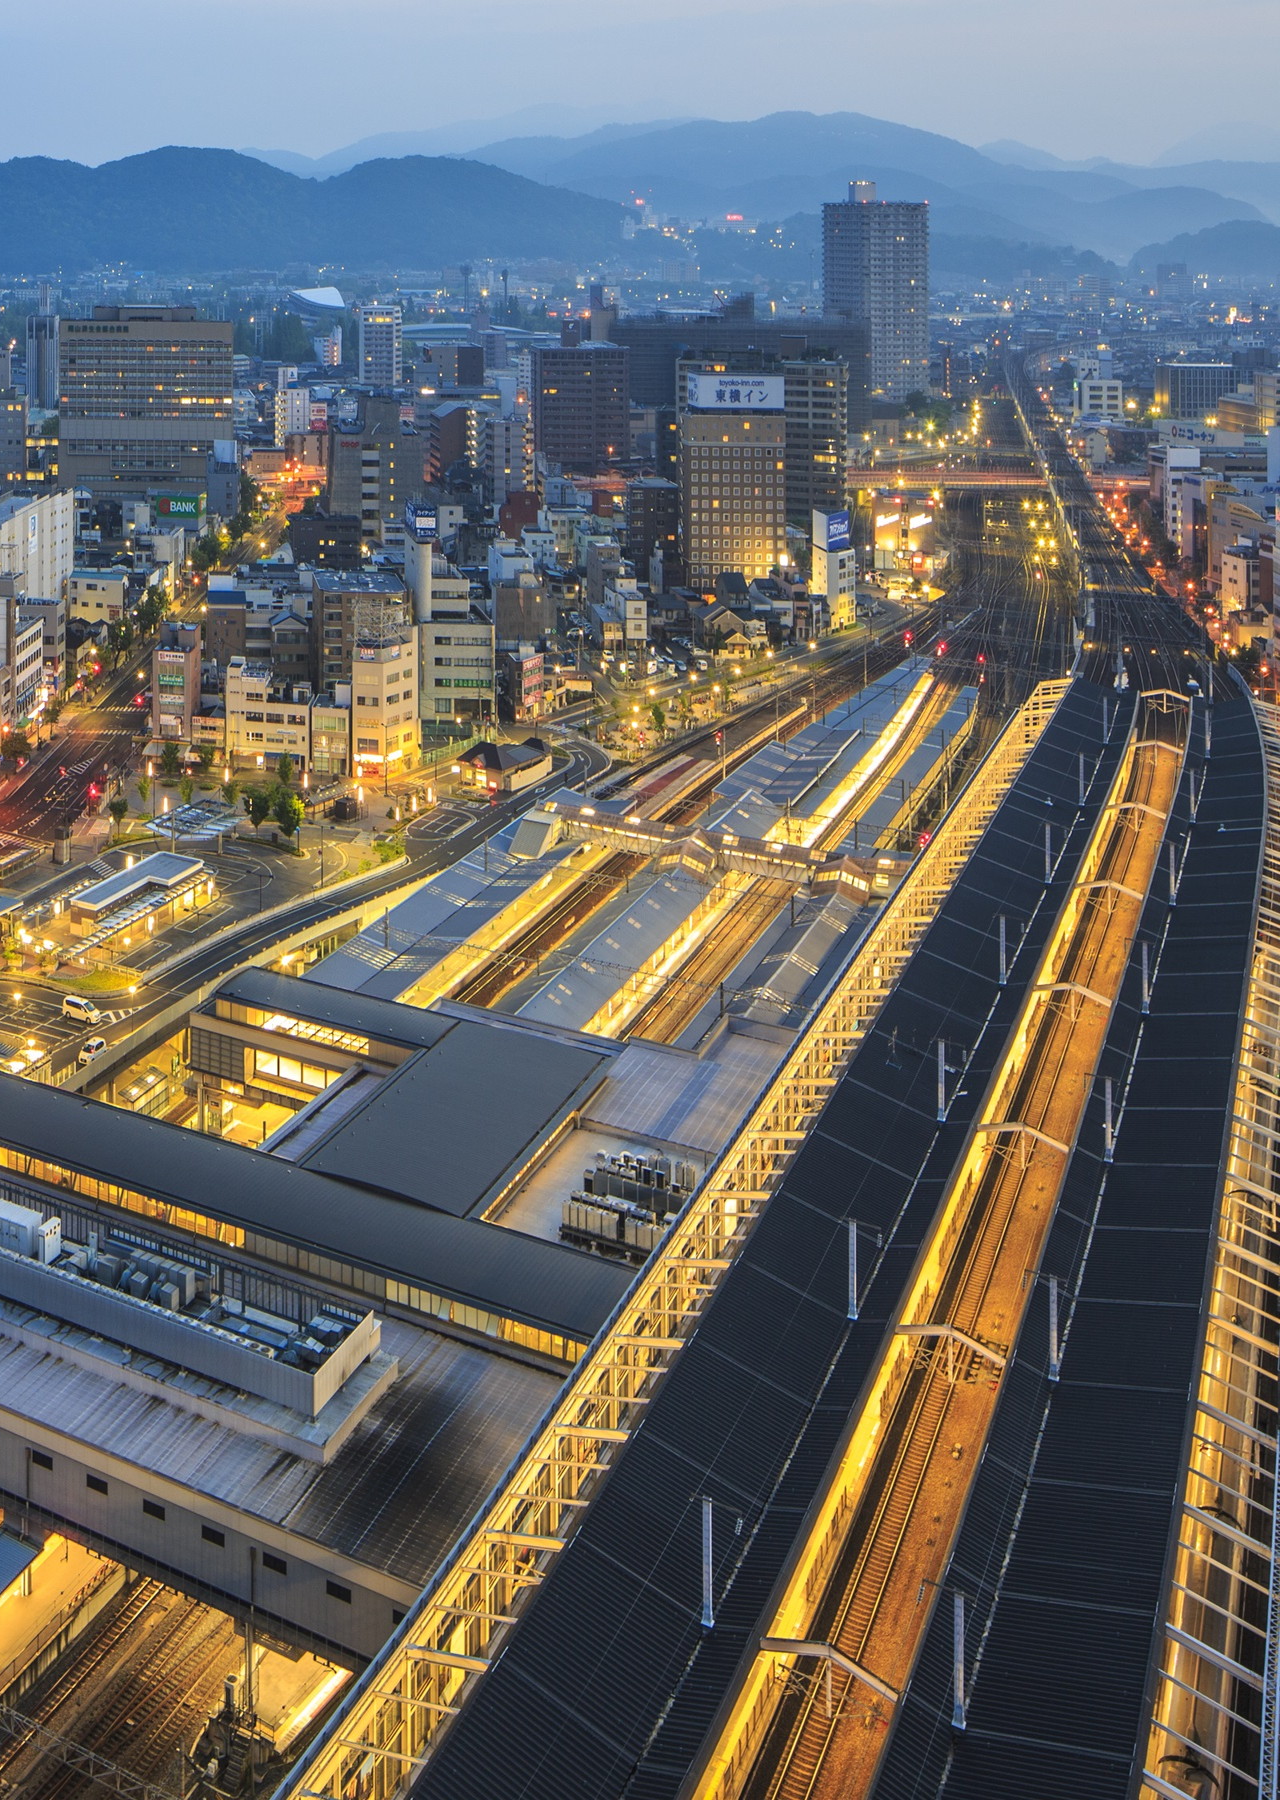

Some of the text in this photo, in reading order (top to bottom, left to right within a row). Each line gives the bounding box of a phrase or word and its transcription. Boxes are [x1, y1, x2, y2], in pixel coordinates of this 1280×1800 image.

[719, 379, 765, 388] toyoko-inn.com
[715, 388, 769, 403] 東横イン
[170, 501, 196, 512] BANK
